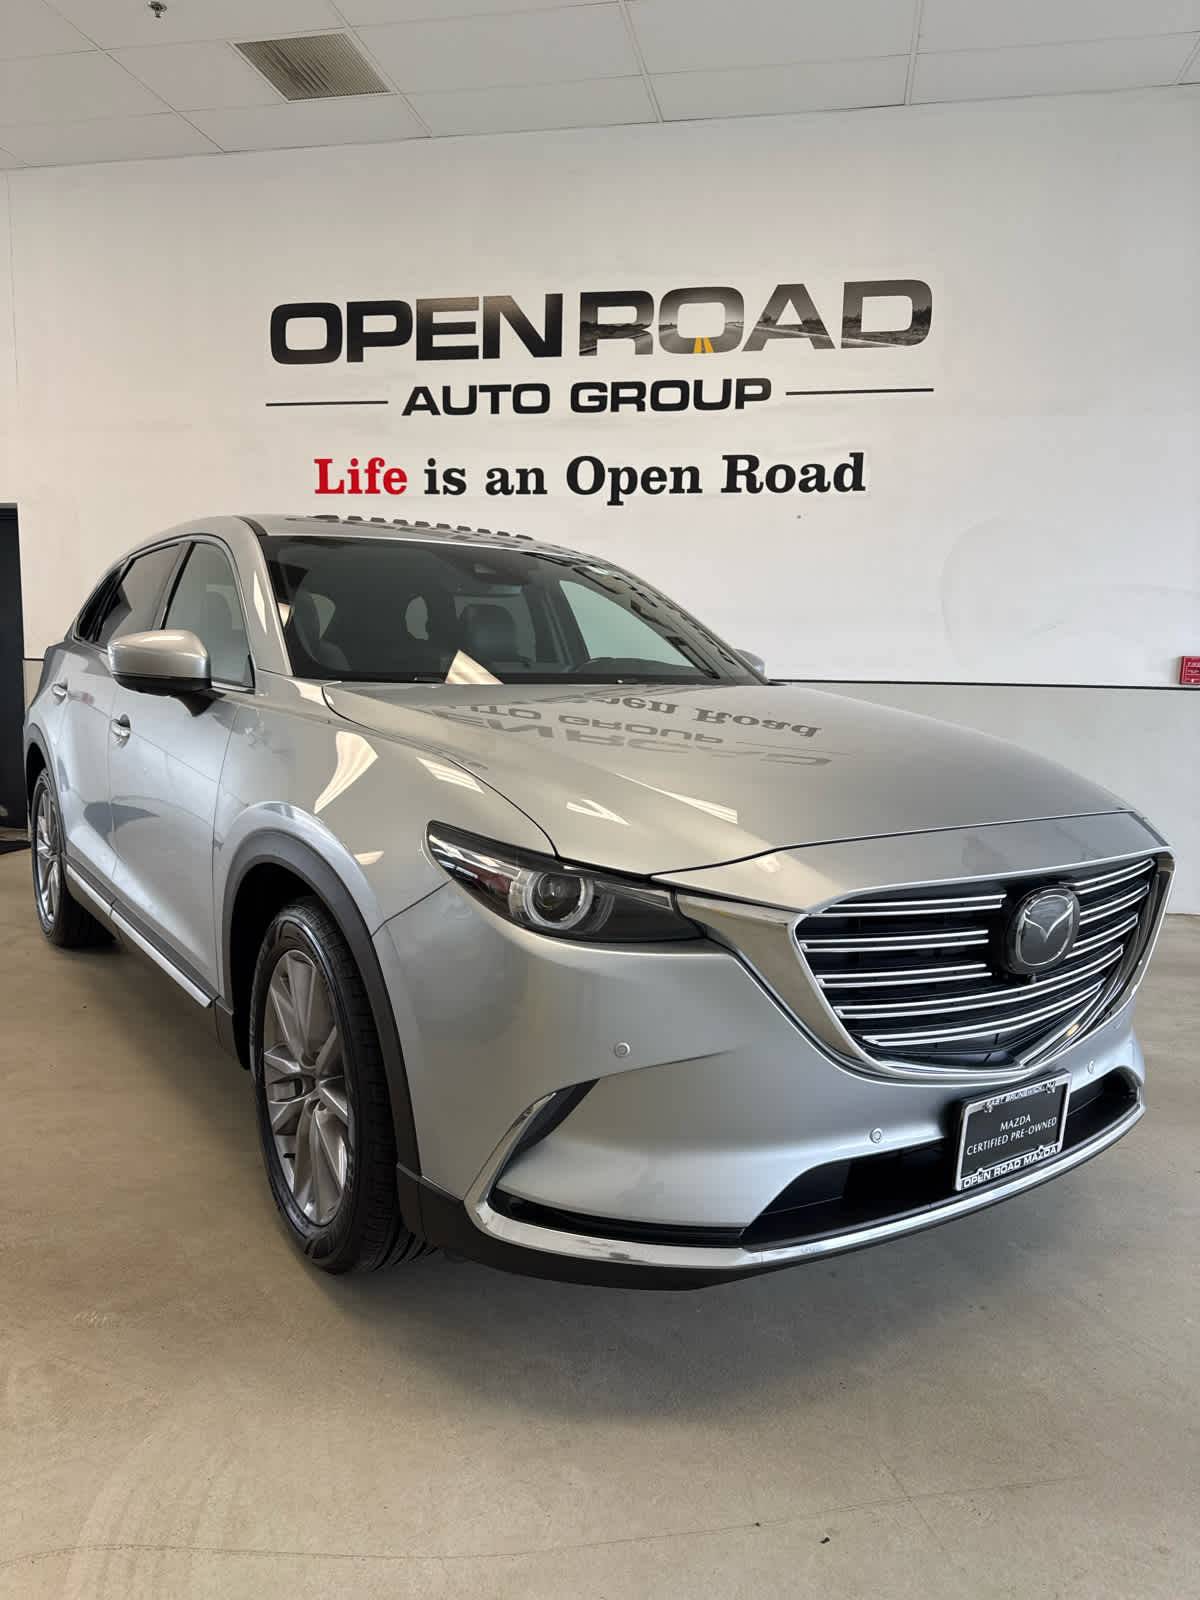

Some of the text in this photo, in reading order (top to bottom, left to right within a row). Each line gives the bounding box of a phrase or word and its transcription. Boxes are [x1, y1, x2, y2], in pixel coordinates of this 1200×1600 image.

[270, 279, 934, 365] OPEN ROAD
[402, 378, 772, 417] AUTO GROUP
[313, 452, 867, 507] Life is an Open Road
[966, 1117, 1057, 1156] CERTIFIED PRE-OWNED
[1000, 1114, 1031, 1131] MAZDA
[963, 1147, 1057, 1188] OPEN ROAD MAZDA
